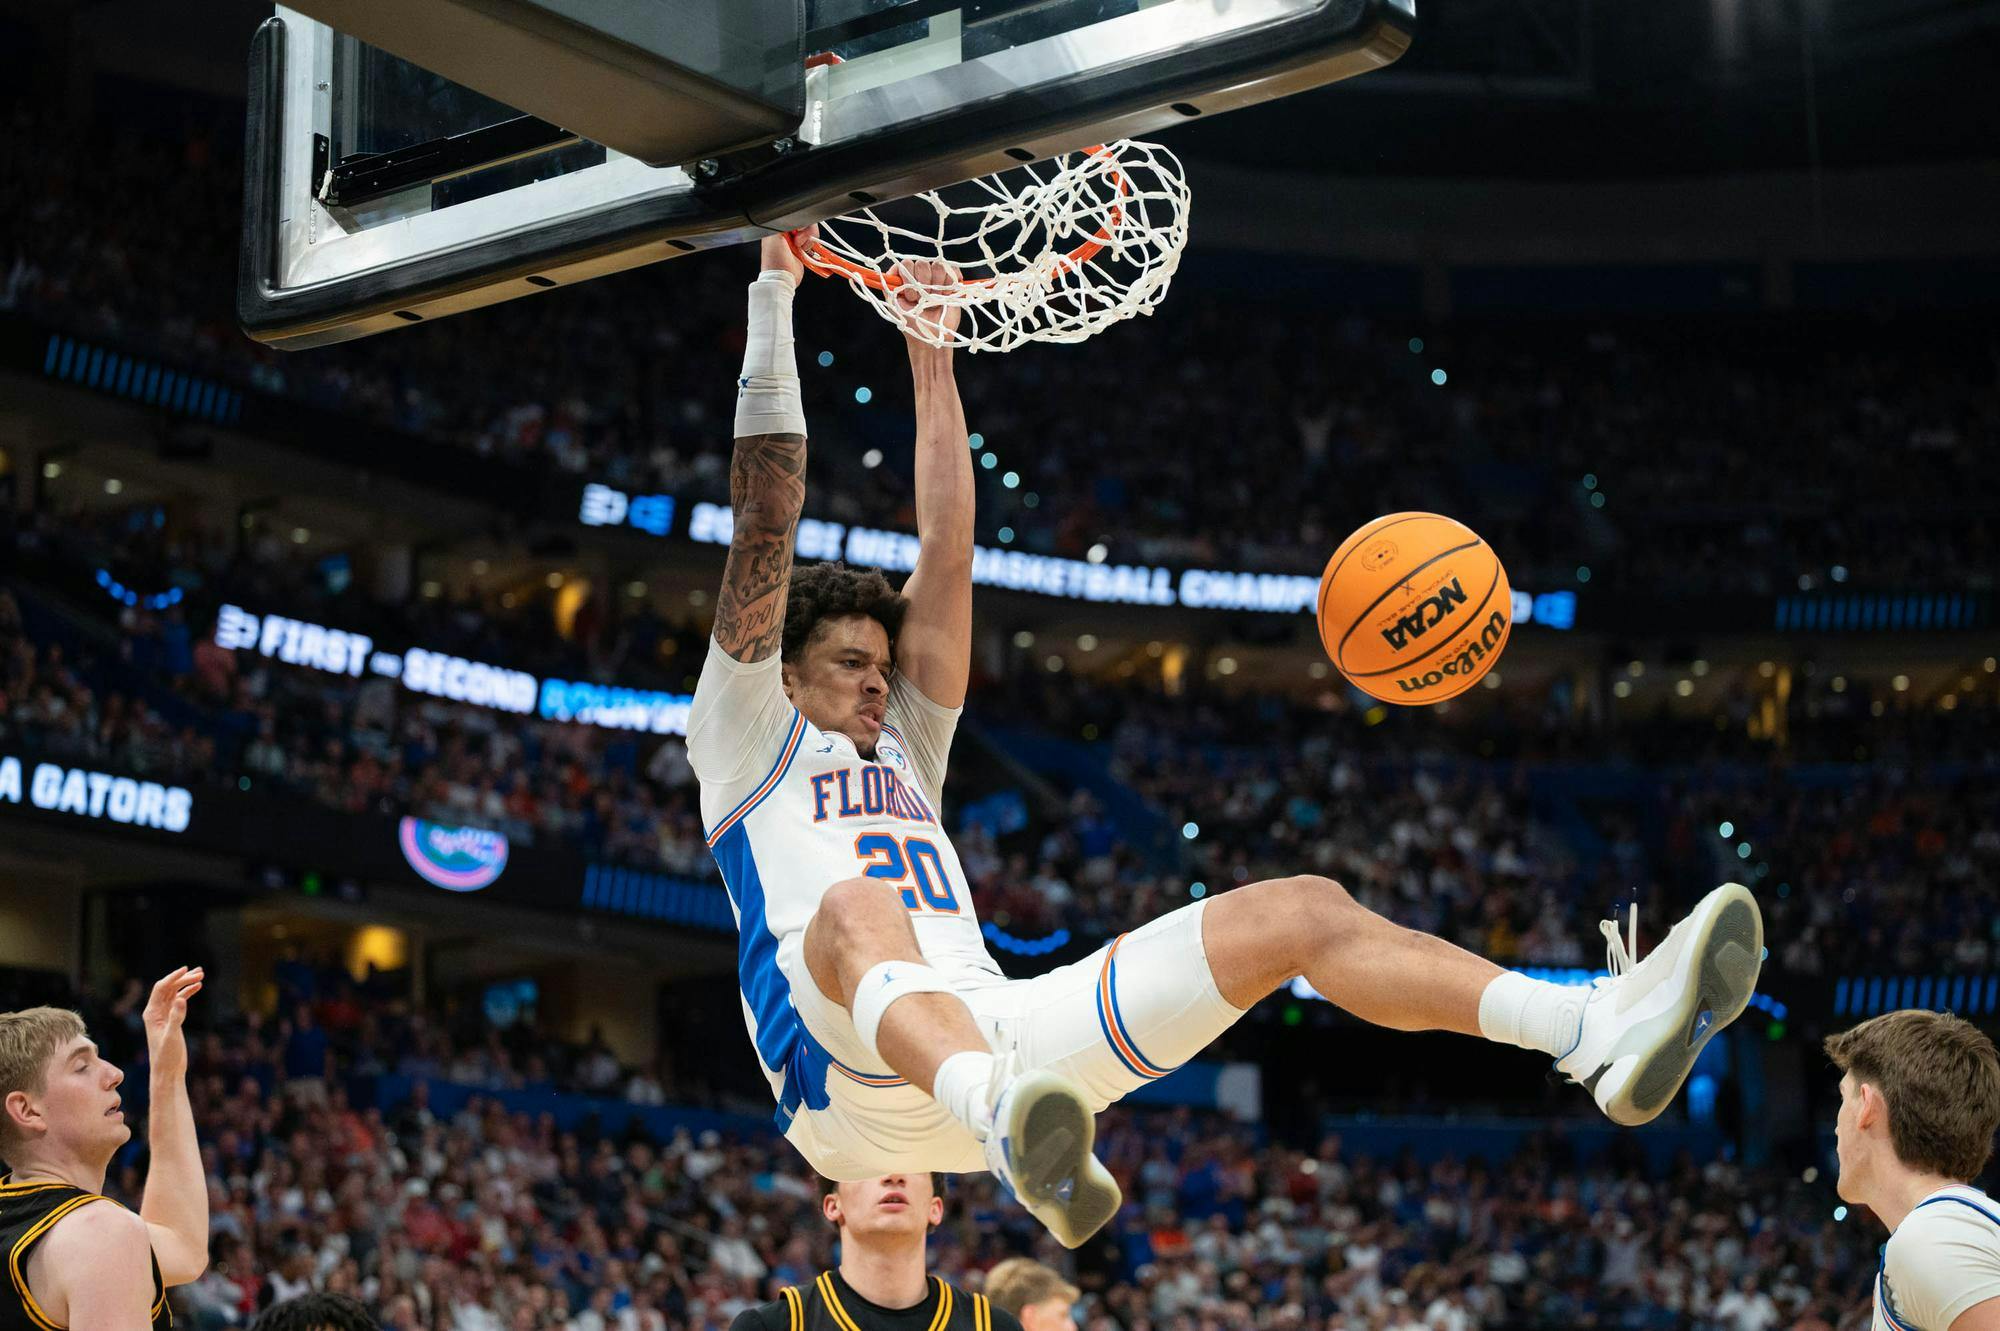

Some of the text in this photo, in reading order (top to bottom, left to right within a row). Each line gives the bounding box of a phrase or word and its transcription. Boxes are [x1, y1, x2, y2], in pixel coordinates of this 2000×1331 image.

[1381, 577, 1468, 651] NCAA
[1396, 610, 1507, 692] Wilson
[259, 613, 373, 678] FIRST
[402, 647, 538, 715] SECOND
[31, 762, 193, 833] GATORS
[854, 832, 961, 915] 20
